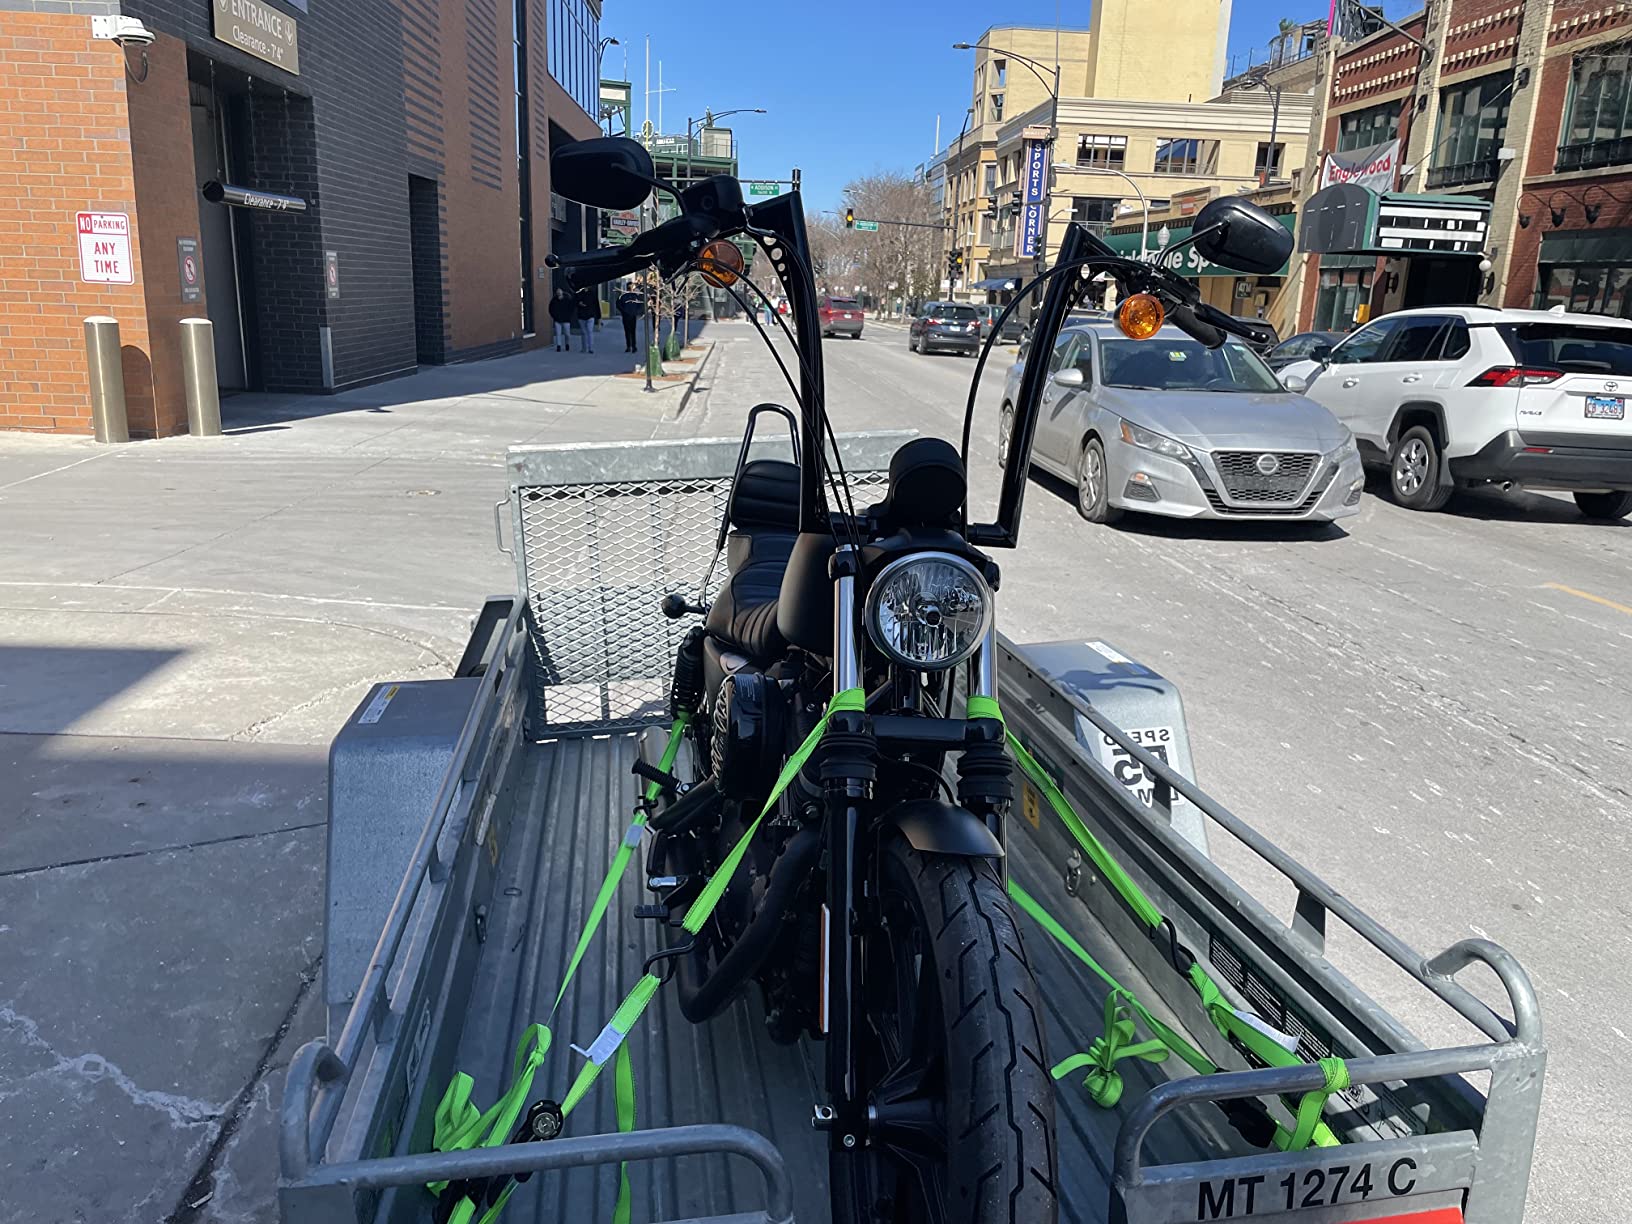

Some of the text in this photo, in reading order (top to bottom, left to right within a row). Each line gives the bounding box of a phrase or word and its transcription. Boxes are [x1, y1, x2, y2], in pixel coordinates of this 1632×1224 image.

[231, 0, 283, 39] ENTRANCE
[232, 25, 267, 54] Clearance
[1031, 143, 1042, 196] SPORTS
[1329, 154, 1391, 184] Englewood
[243, 193, 274, 209] Clearance
[79, 216, 126, 231] NO PARKING
[94, 241, 116, 256] ANY
[94, 259, 120, 274] TIME
[1197, 1156, 1418, 1221] MT 1274 C
